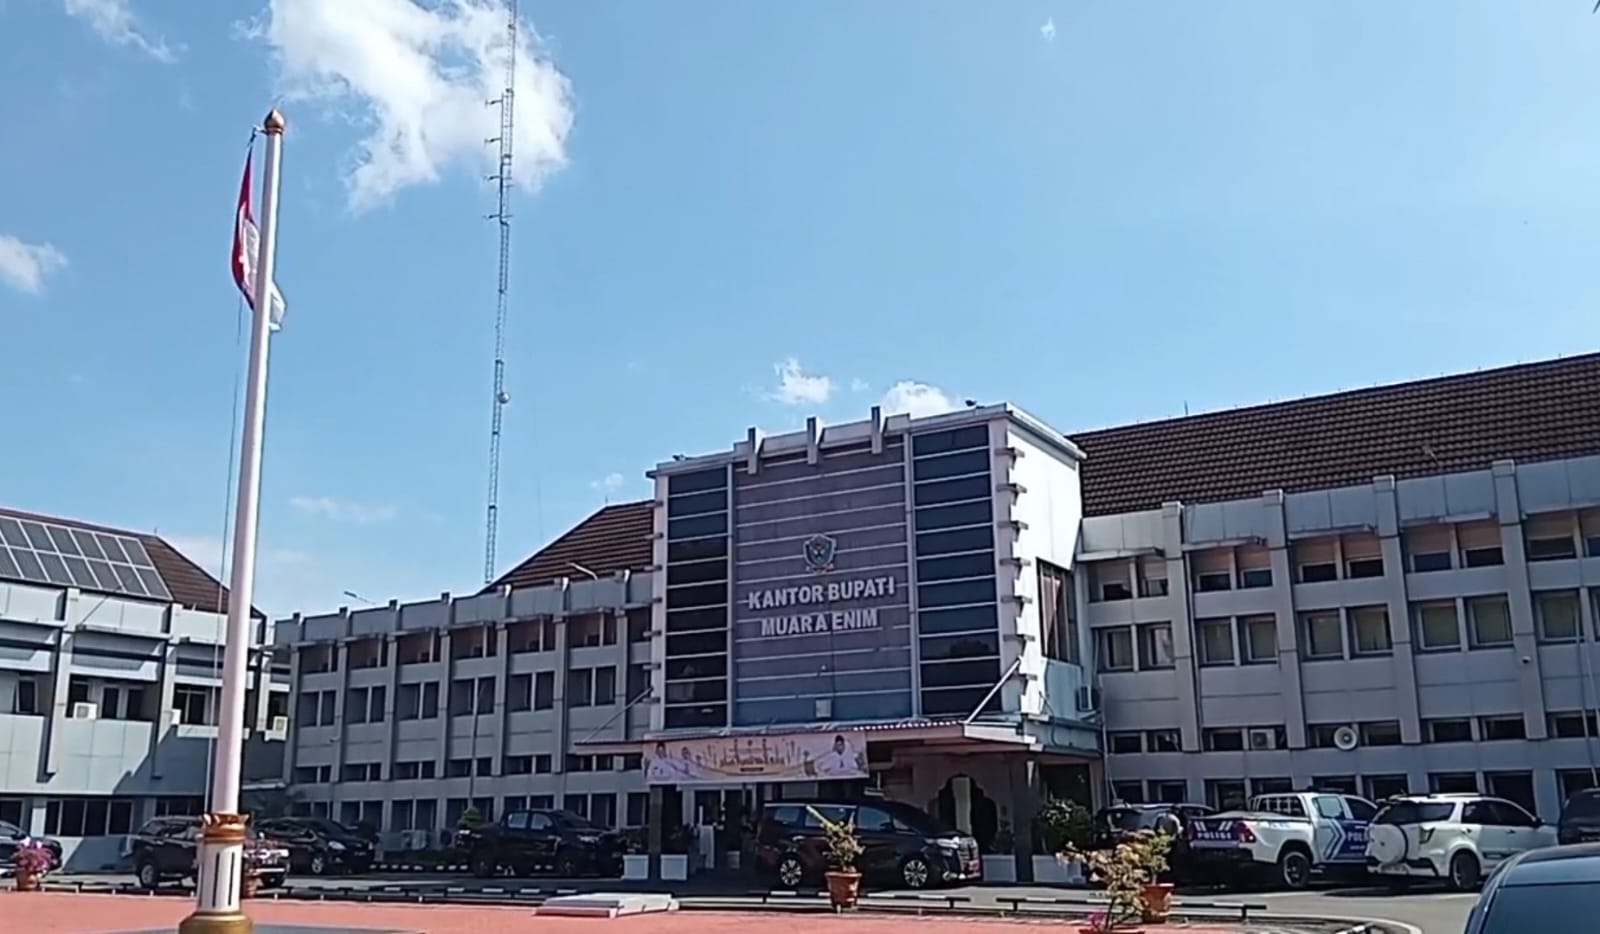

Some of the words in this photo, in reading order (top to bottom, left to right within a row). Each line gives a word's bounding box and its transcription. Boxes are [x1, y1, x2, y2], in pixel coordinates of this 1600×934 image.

[748, 585, 824, 609] KANTOR
[828, 576, 895, 601] BUPATI
[761, 614, 828, 636] MUARA
[832, 608, 878, 630] ENIM
